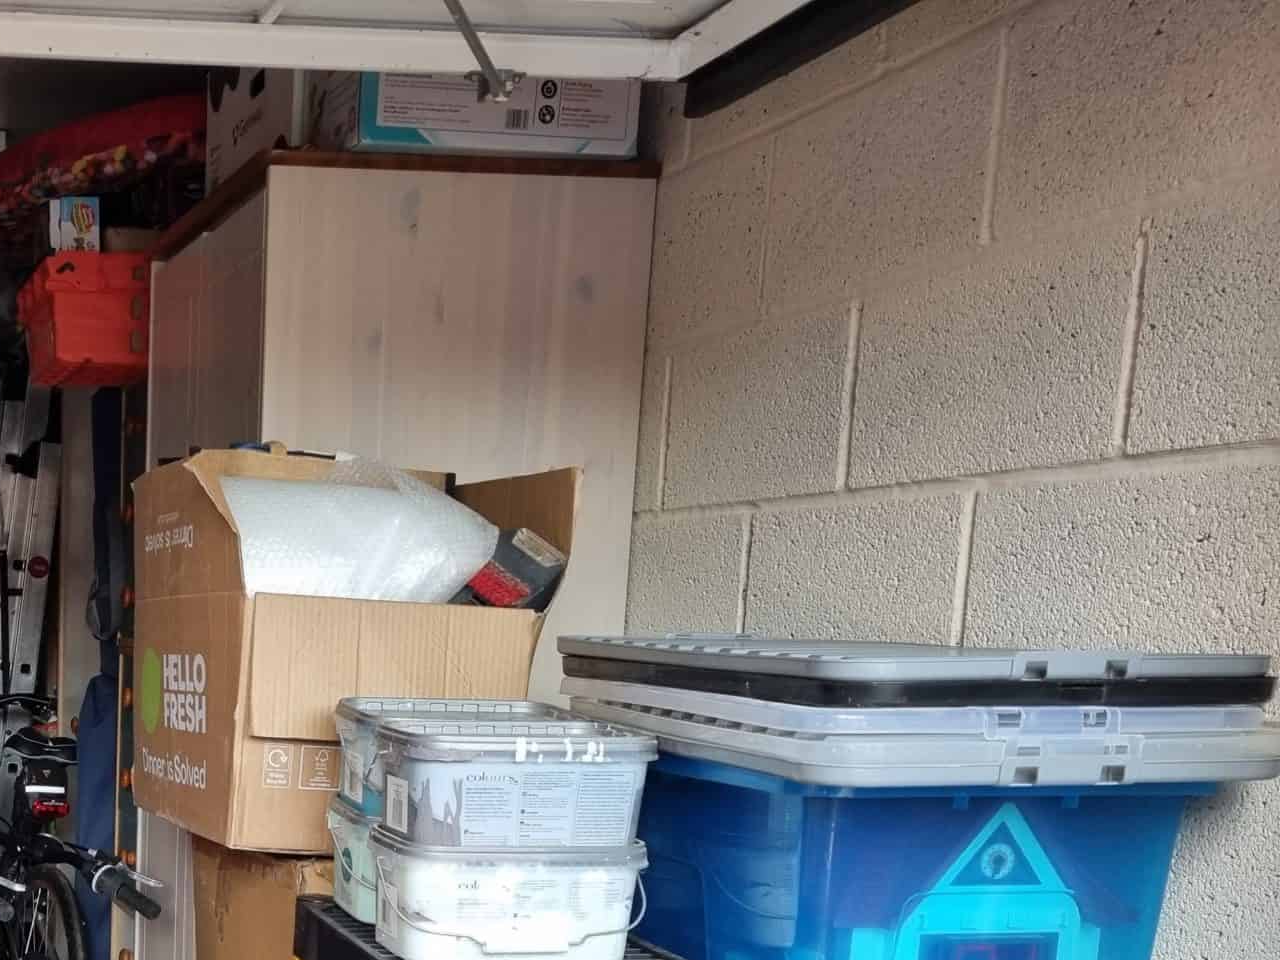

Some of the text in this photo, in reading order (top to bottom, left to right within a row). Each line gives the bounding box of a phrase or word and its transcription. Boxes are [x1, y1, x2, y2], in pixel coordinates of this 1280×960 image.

[162, 653, 206, 693] HELLO
[163, 692, 207, 734] FRESH
[142, 746, 167, 777] Dinner
[173, 753, 206, 789] Solved
